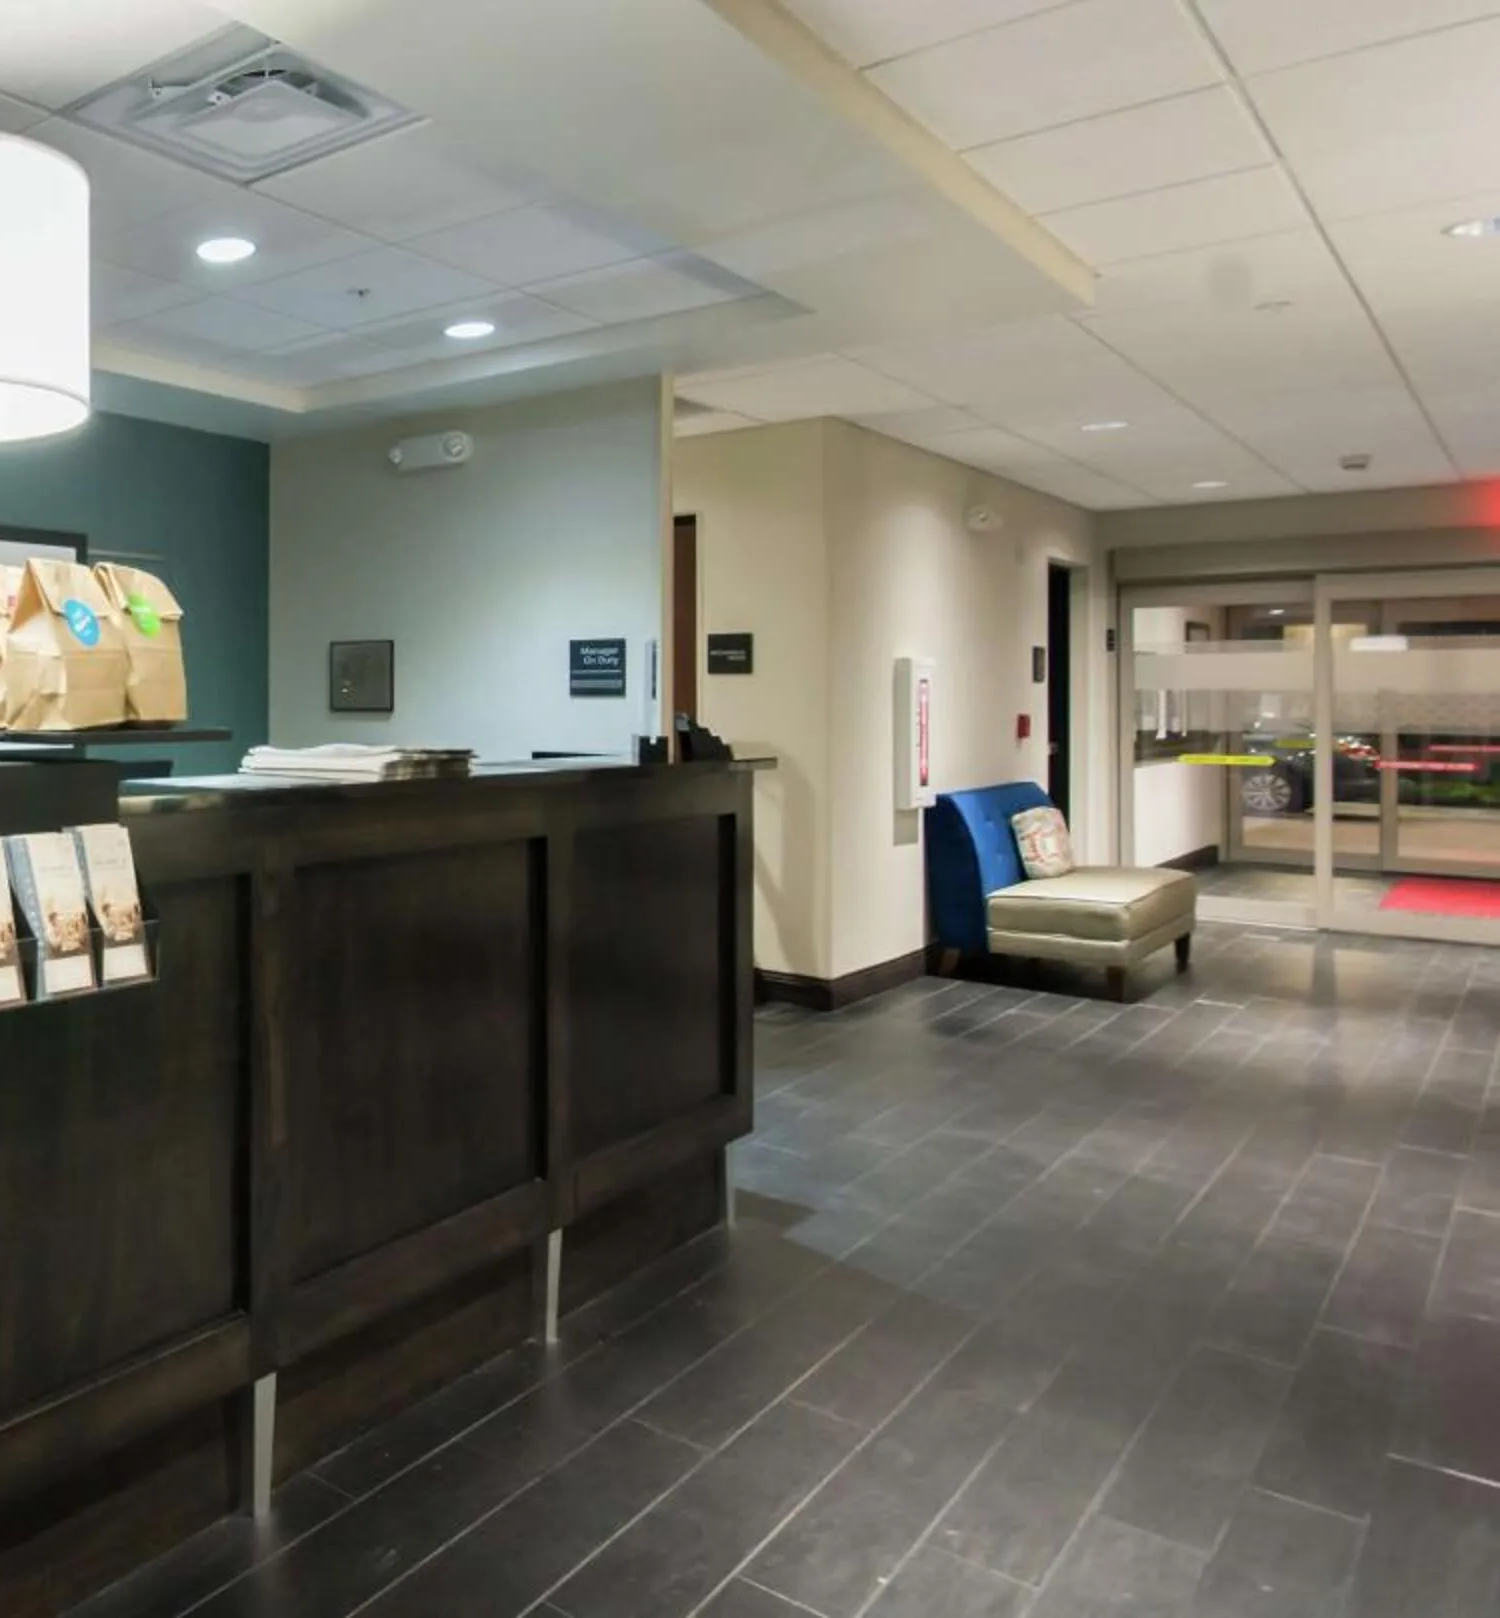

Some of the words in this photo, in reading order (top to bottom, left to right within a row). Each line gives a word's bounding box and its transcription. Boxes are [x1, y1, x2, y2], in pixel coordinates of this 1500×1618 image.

[580, 646, 618, 657] Manager
[583, 656, 597, 665] On
[598, 655, 619, 667] Duty
